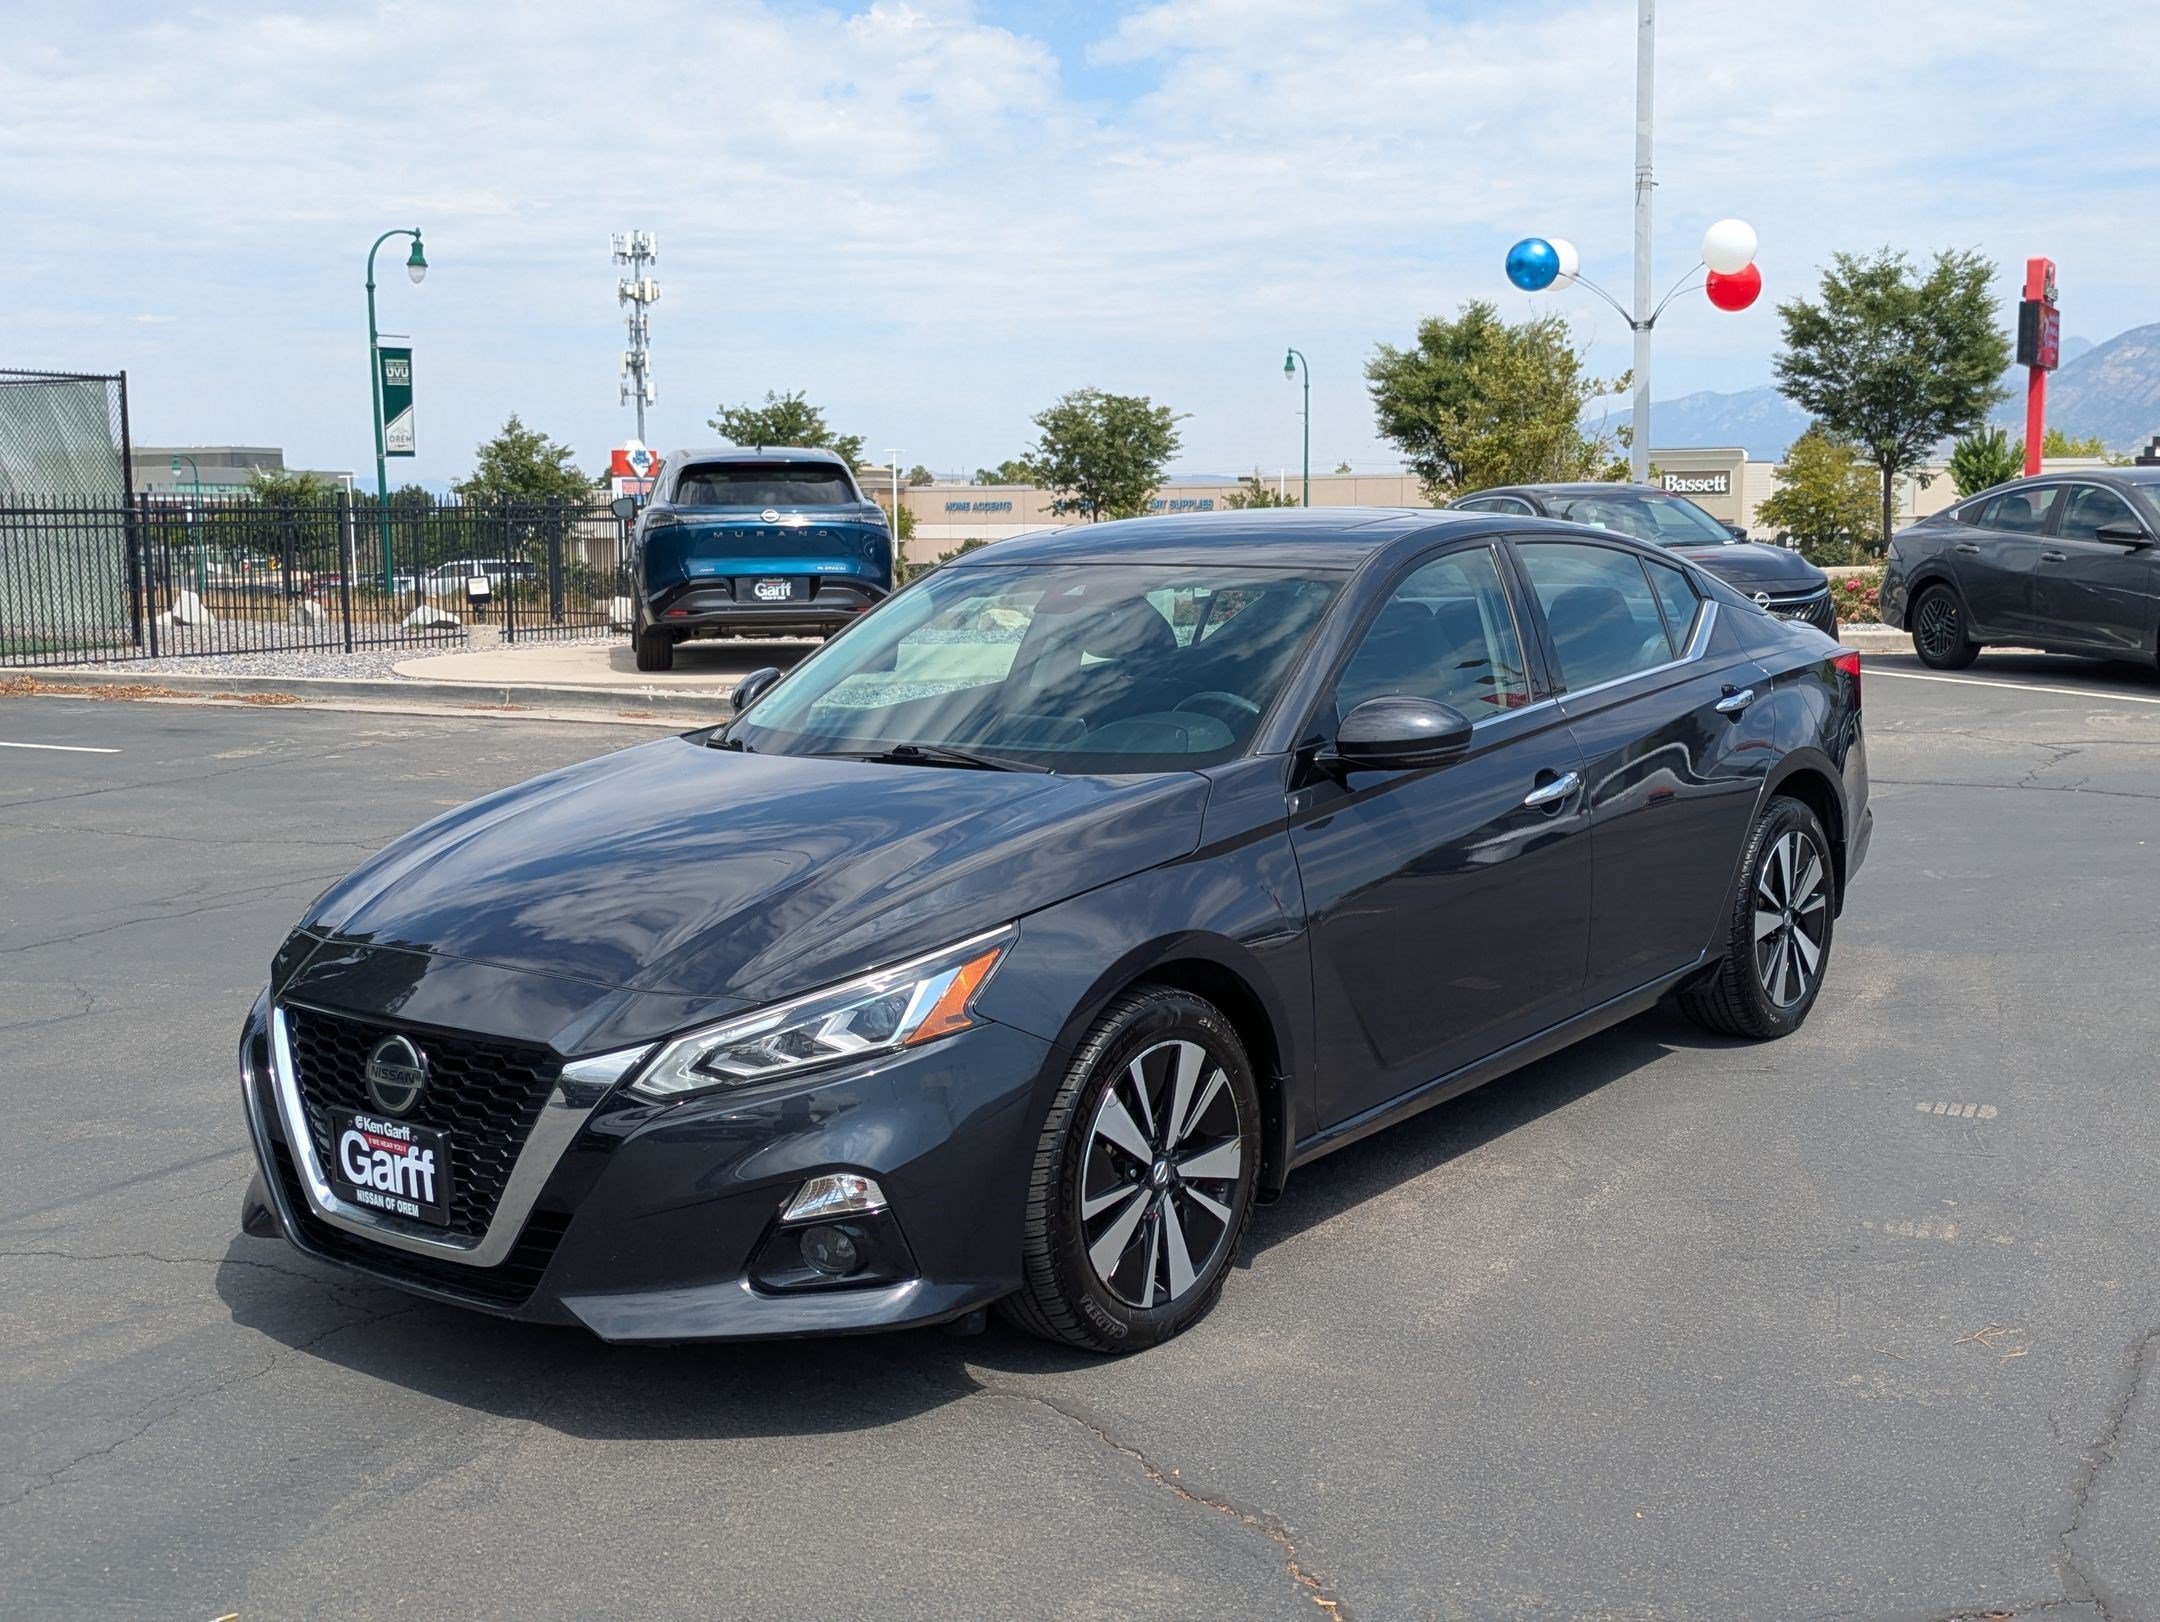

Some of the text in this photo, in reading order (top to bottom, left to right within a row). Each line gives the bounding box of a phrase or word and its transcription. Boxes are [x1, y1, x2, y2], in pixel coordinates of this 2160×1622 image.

[386, 367, 409, 378] UVU
[389, 435, 412, 443] OREM
[1664, 474, 1727, 492] Bassett
[945, 501, 1013, 512] HOME ACCENTS
[1168, 499, 1214, 510] SUPPLIES
[713, 530, 828, 538] MURANO
[754, 582, 792, 597] Garff
[371, 1064, 416, 1085] NISSAN
[363, 1116, 410, 1141] Ken Garff
[380, 1140, 394, 1150] HEAR
[340, 1130, 435, 1203] Garff
[356, 1189, 419, 1218] NISSAN OF OREM
